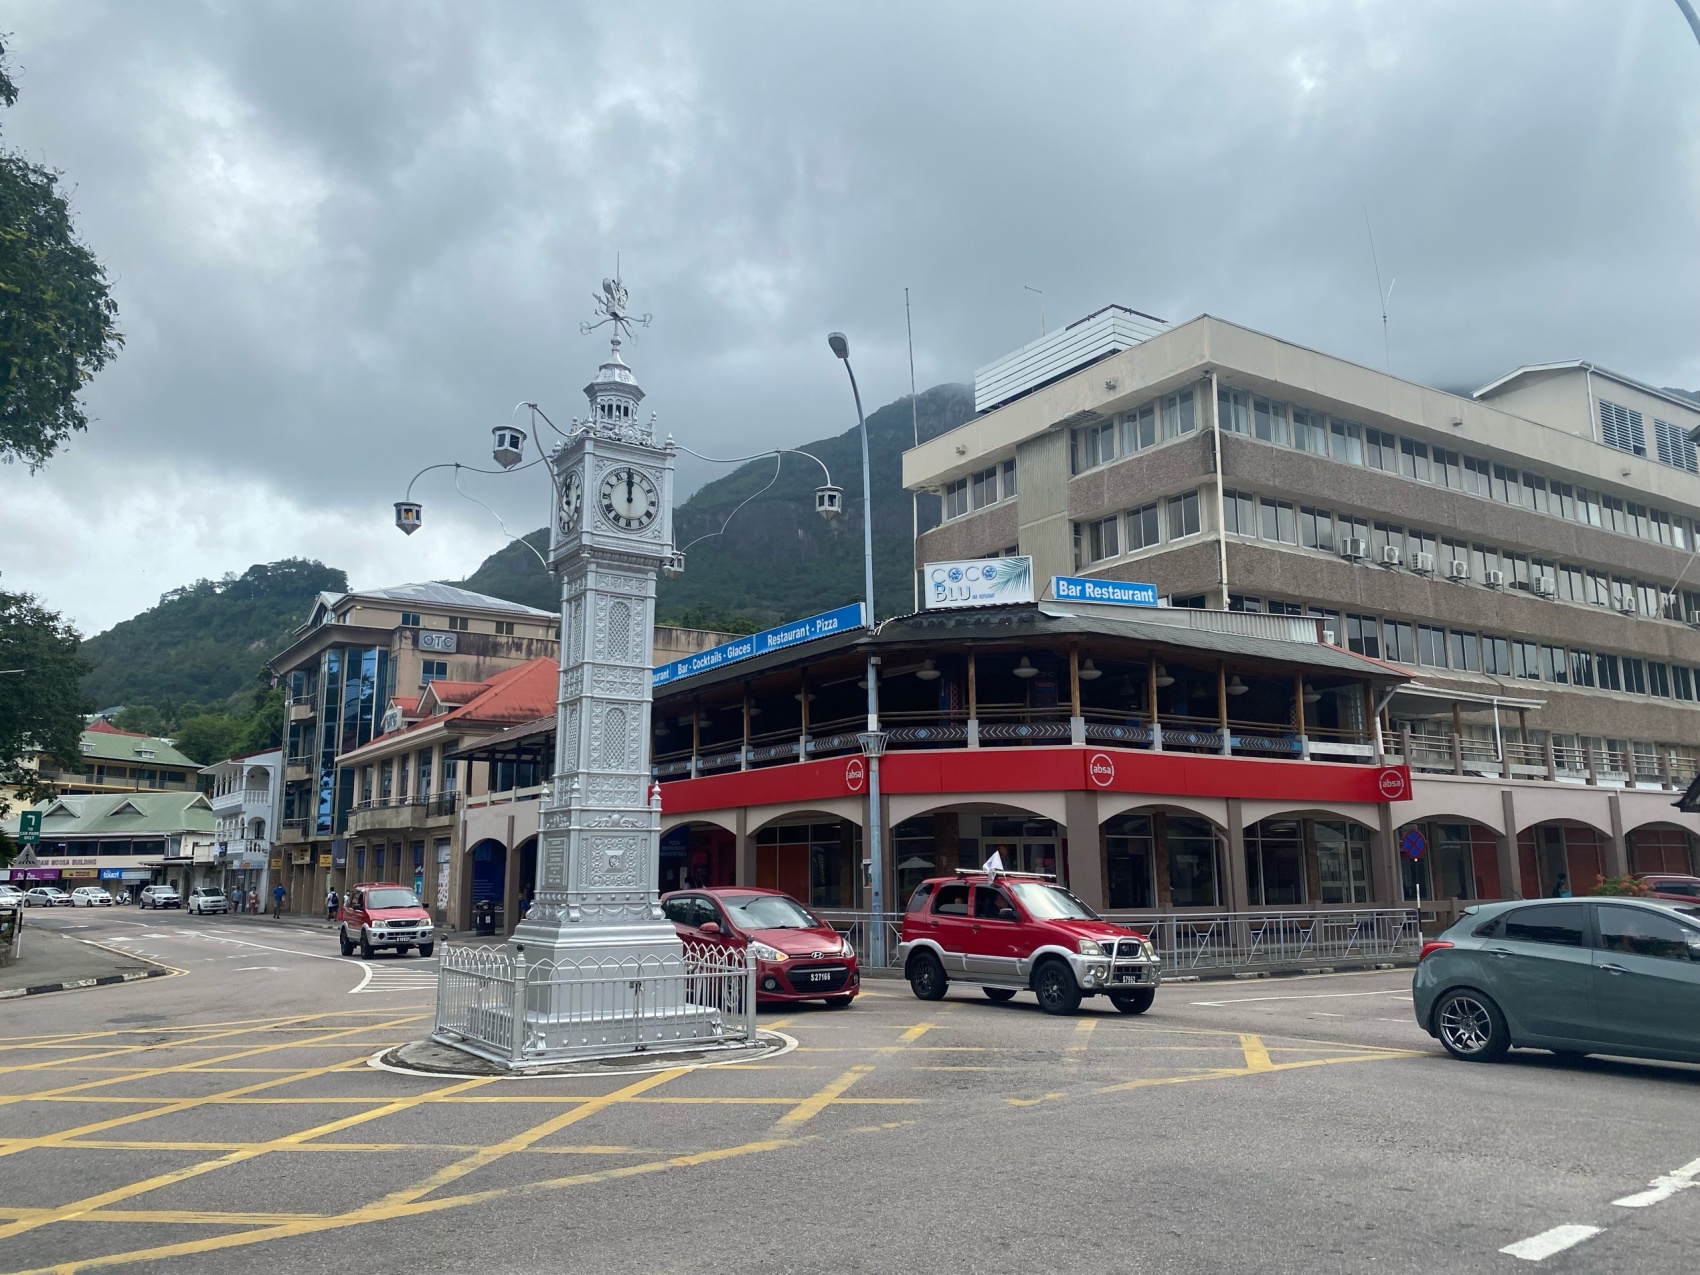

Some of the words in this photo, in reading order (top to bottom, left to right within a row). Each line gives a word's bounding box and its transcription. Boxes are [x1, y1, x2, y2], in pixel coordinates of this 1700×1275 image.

[931, 564, 998, 584] COCO
[934, 583, 971, 603] BLU
[1059, 580, 1082, 597] Bar
[1085, 583, 1154, 603] Restaurant
[423, 634, 454, 650] OTC
[767, 623, 810, 647] Restaurant
[816, 617, 838, 633] Pizza
[678, 663, 688, 675] Bar
[692, 652, 723, 670] Cocktails
[727, 643, 751, 659] Glaces
[848, 769, 862, 779] absa
[1093, 763, 1112, 775] absa
[1382, 779, 1401, 788] absa
